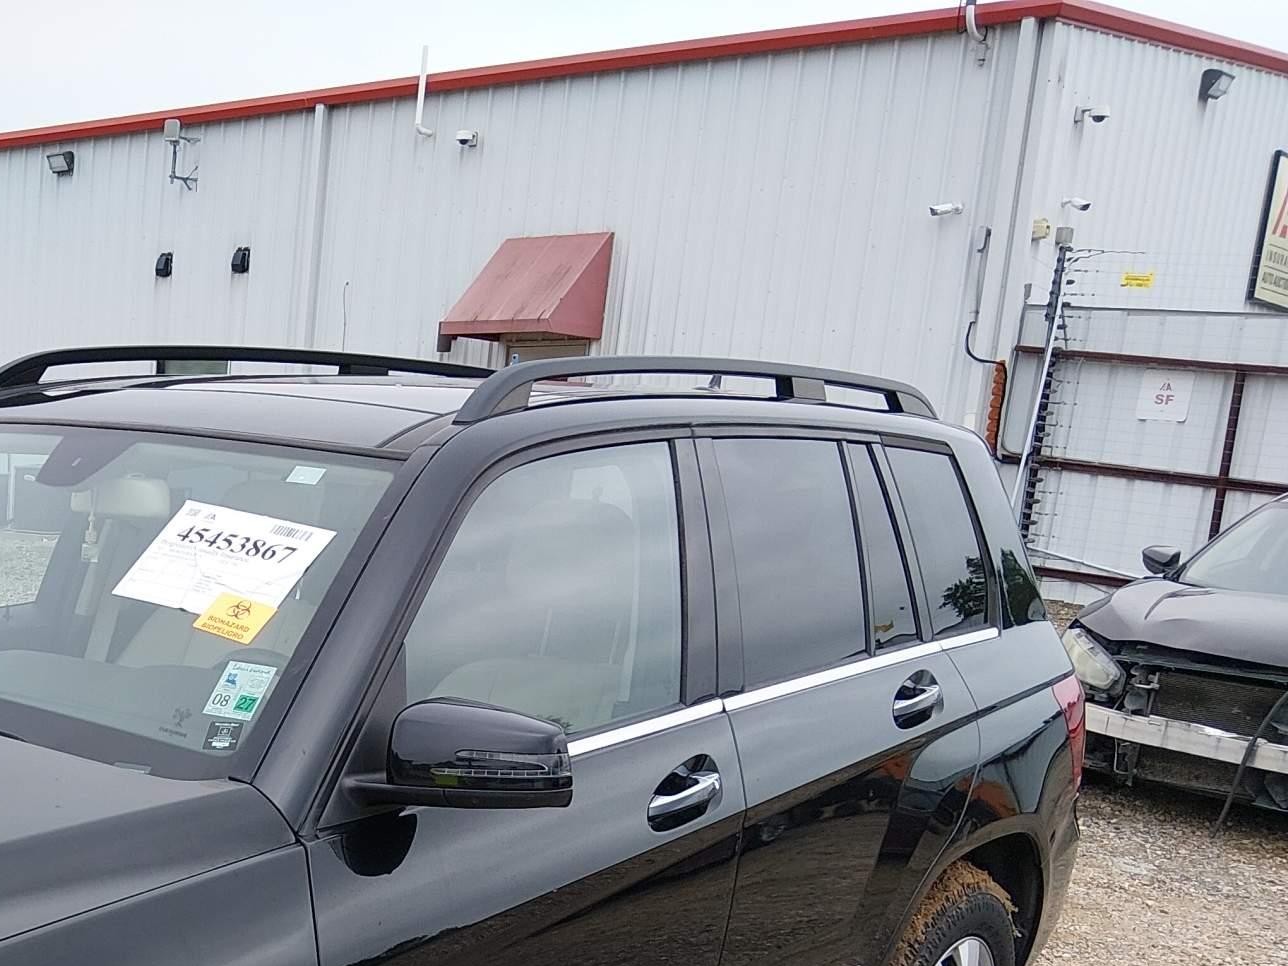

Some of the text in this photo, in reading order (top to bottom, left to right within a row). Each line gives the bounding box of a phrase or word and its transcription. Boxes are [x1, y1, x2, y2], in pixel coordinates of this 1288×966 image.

[1154, 394, 1175, 405] SF
[177, 525, 298, 564] 45453867
[201, 622, 244, 640] BIOPELIGRO
[207, 615, 250, 633] BIOHAZARD
[212, 693, 231, 707] 08
[235, 696, 257, 711] 27
